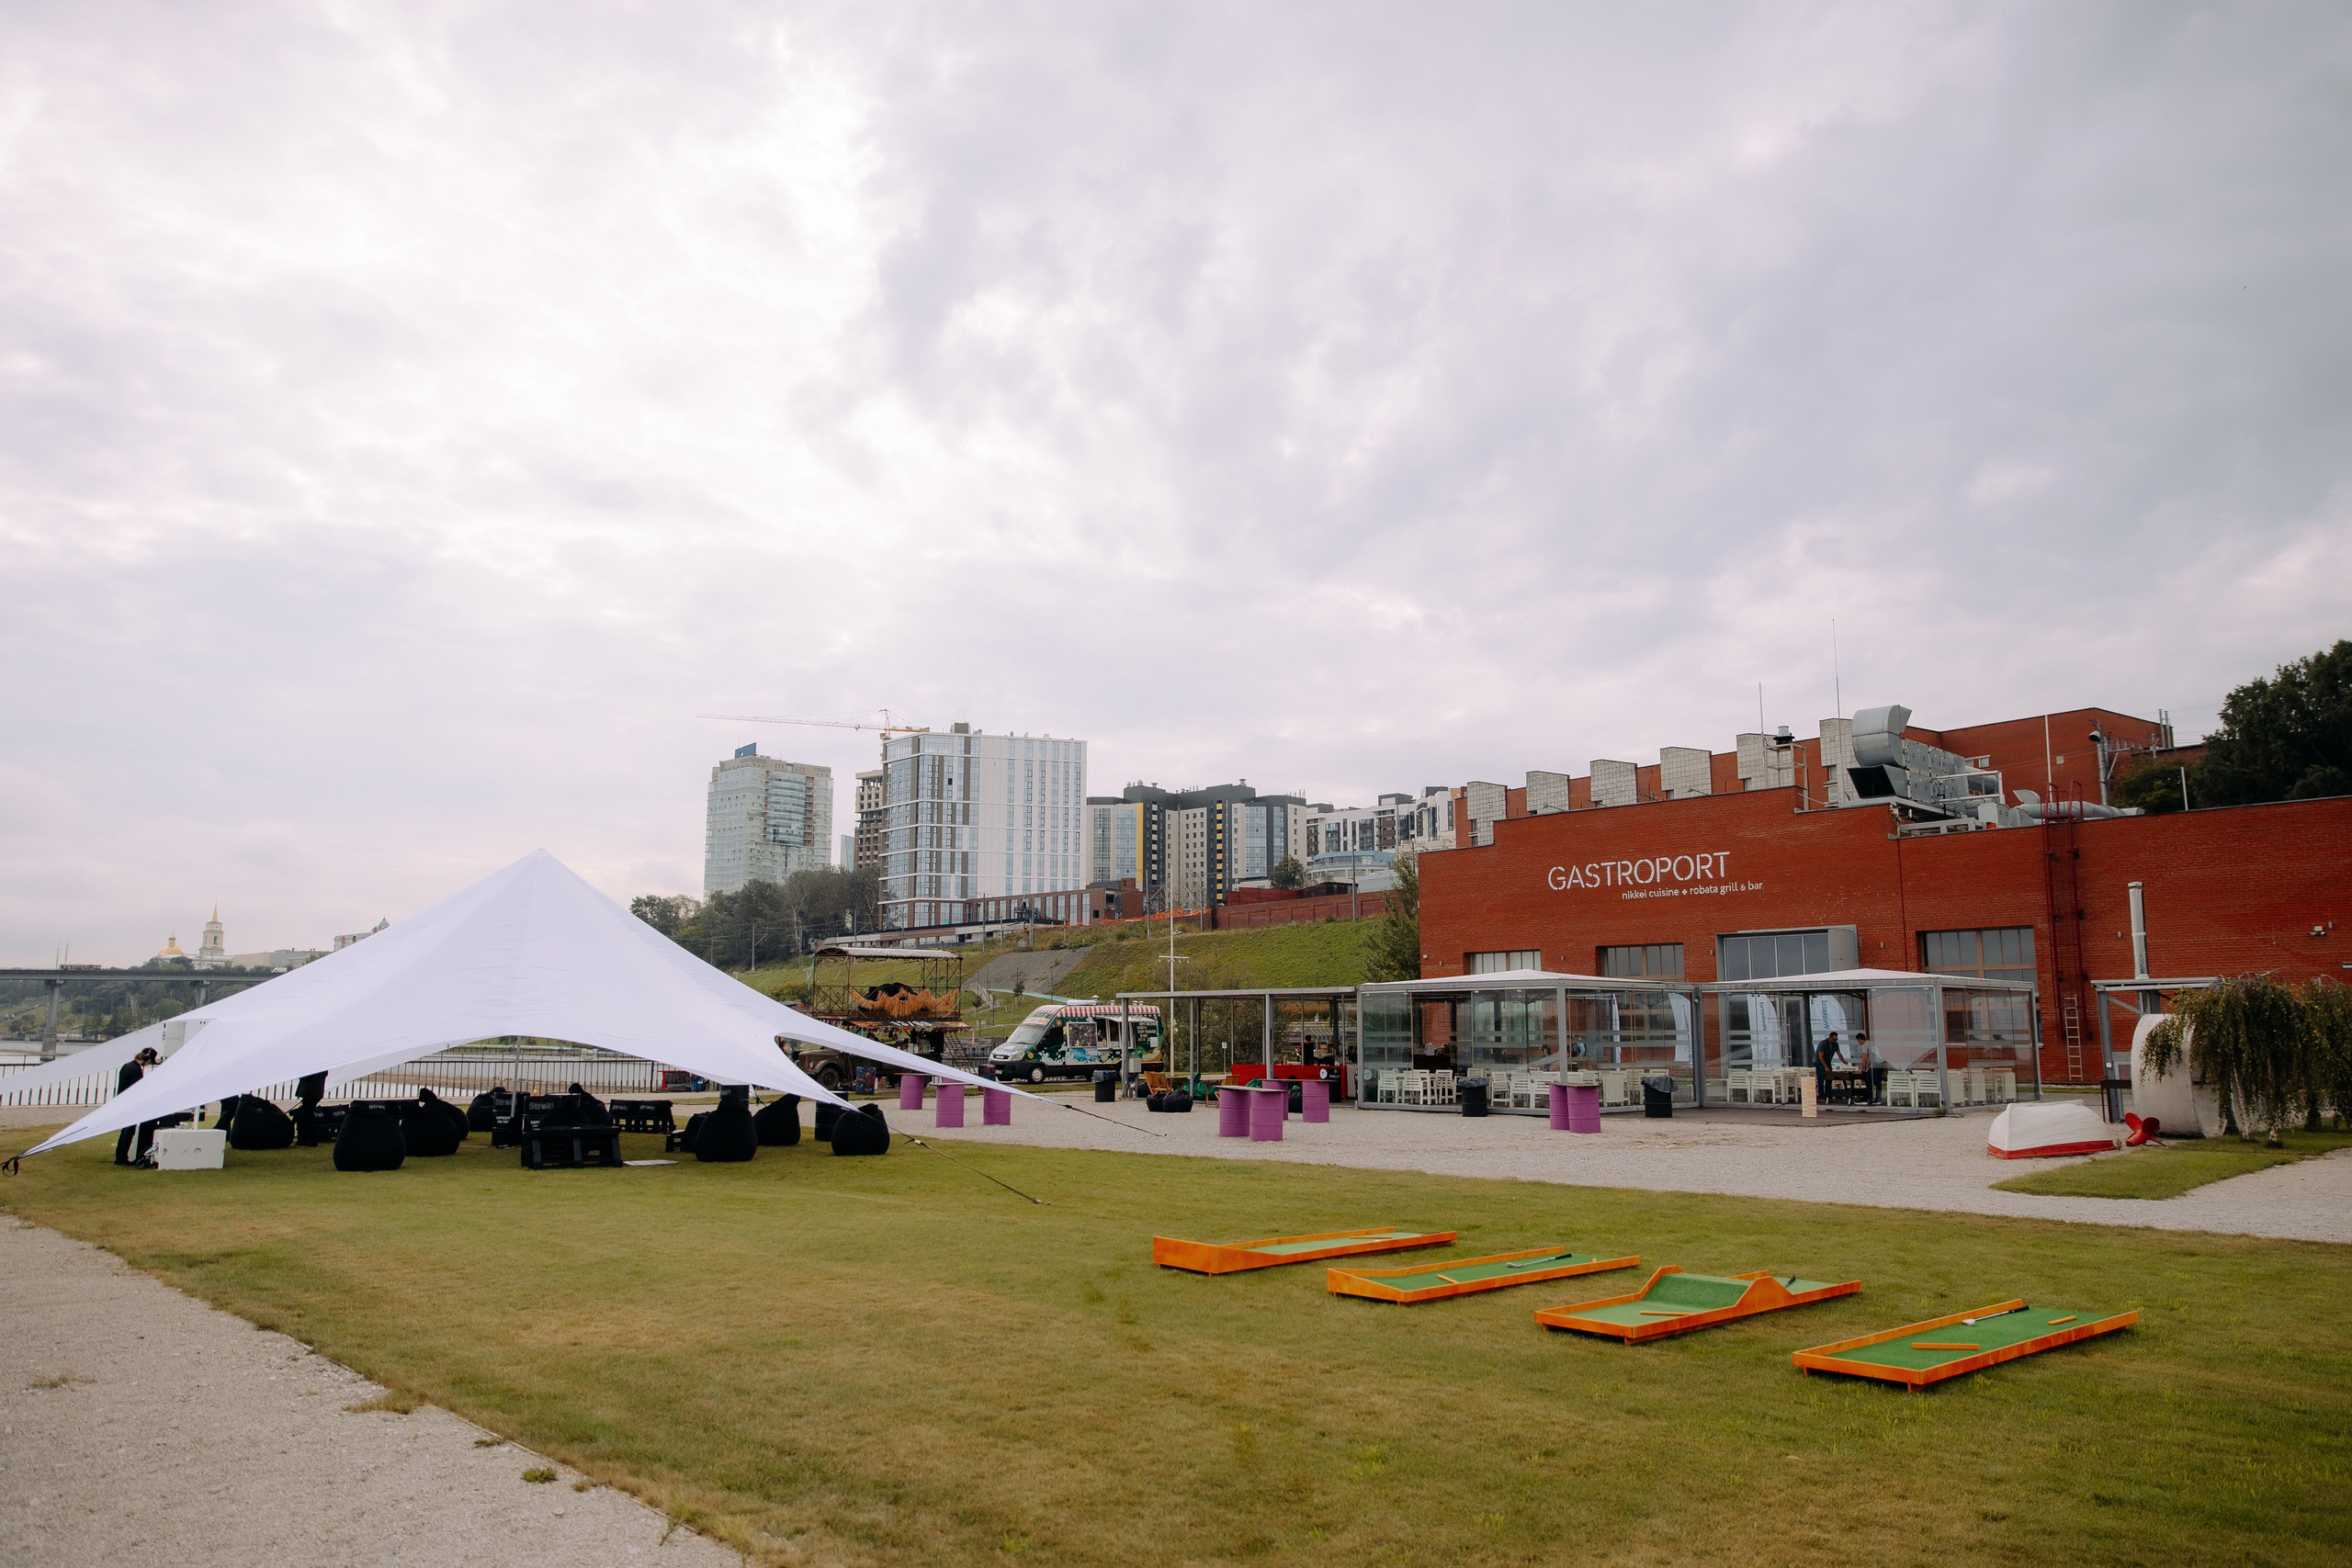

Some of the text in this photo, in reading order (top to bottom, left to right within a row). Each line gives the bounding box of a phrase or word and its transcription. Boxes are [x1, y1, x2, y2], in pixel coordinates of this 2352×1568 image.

[1547, 851, 1730, 890] GASTROPORT
[1622, 881, 1763, 900] nikkei cuisine robata grill & bar
